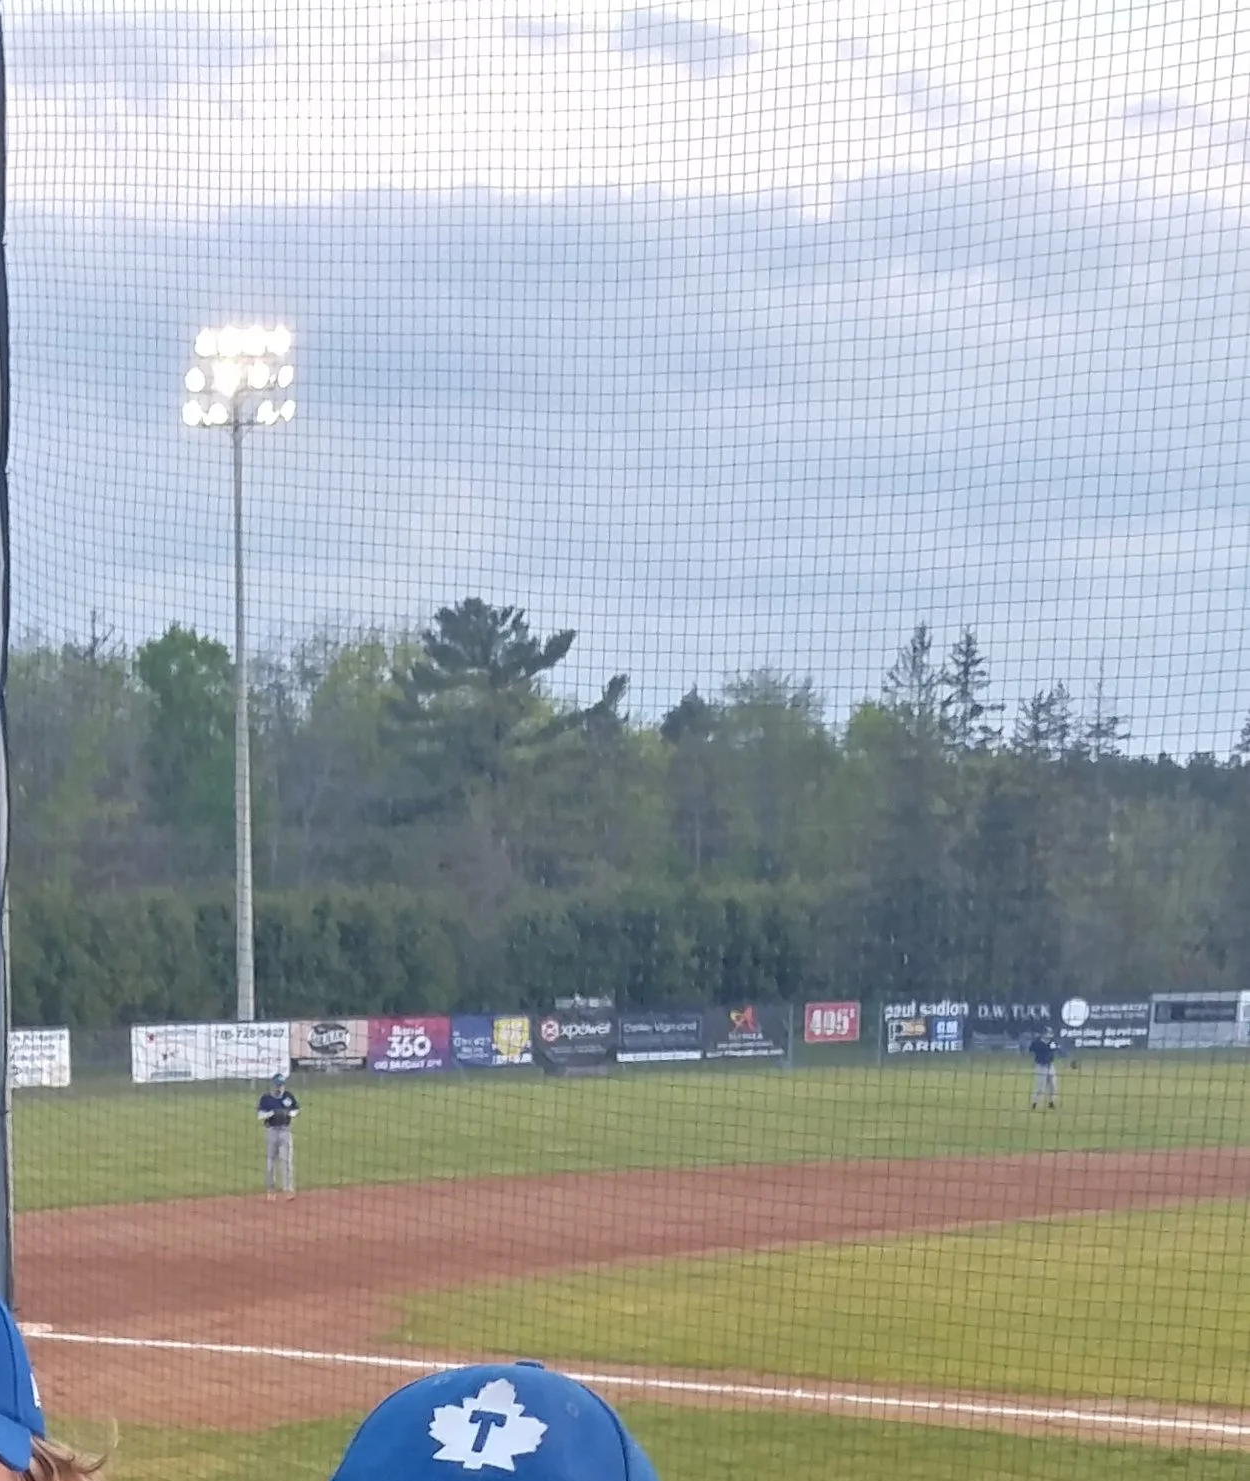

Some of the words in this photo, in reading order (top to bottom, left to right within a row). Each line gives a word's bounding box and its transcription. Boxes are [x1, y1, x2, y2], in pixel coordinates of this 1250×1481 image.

[386, 1035, 432, 1059] 360
[887, 1040, 960, 1053] BARRIE
[468, 1409, 508, 1453] T
